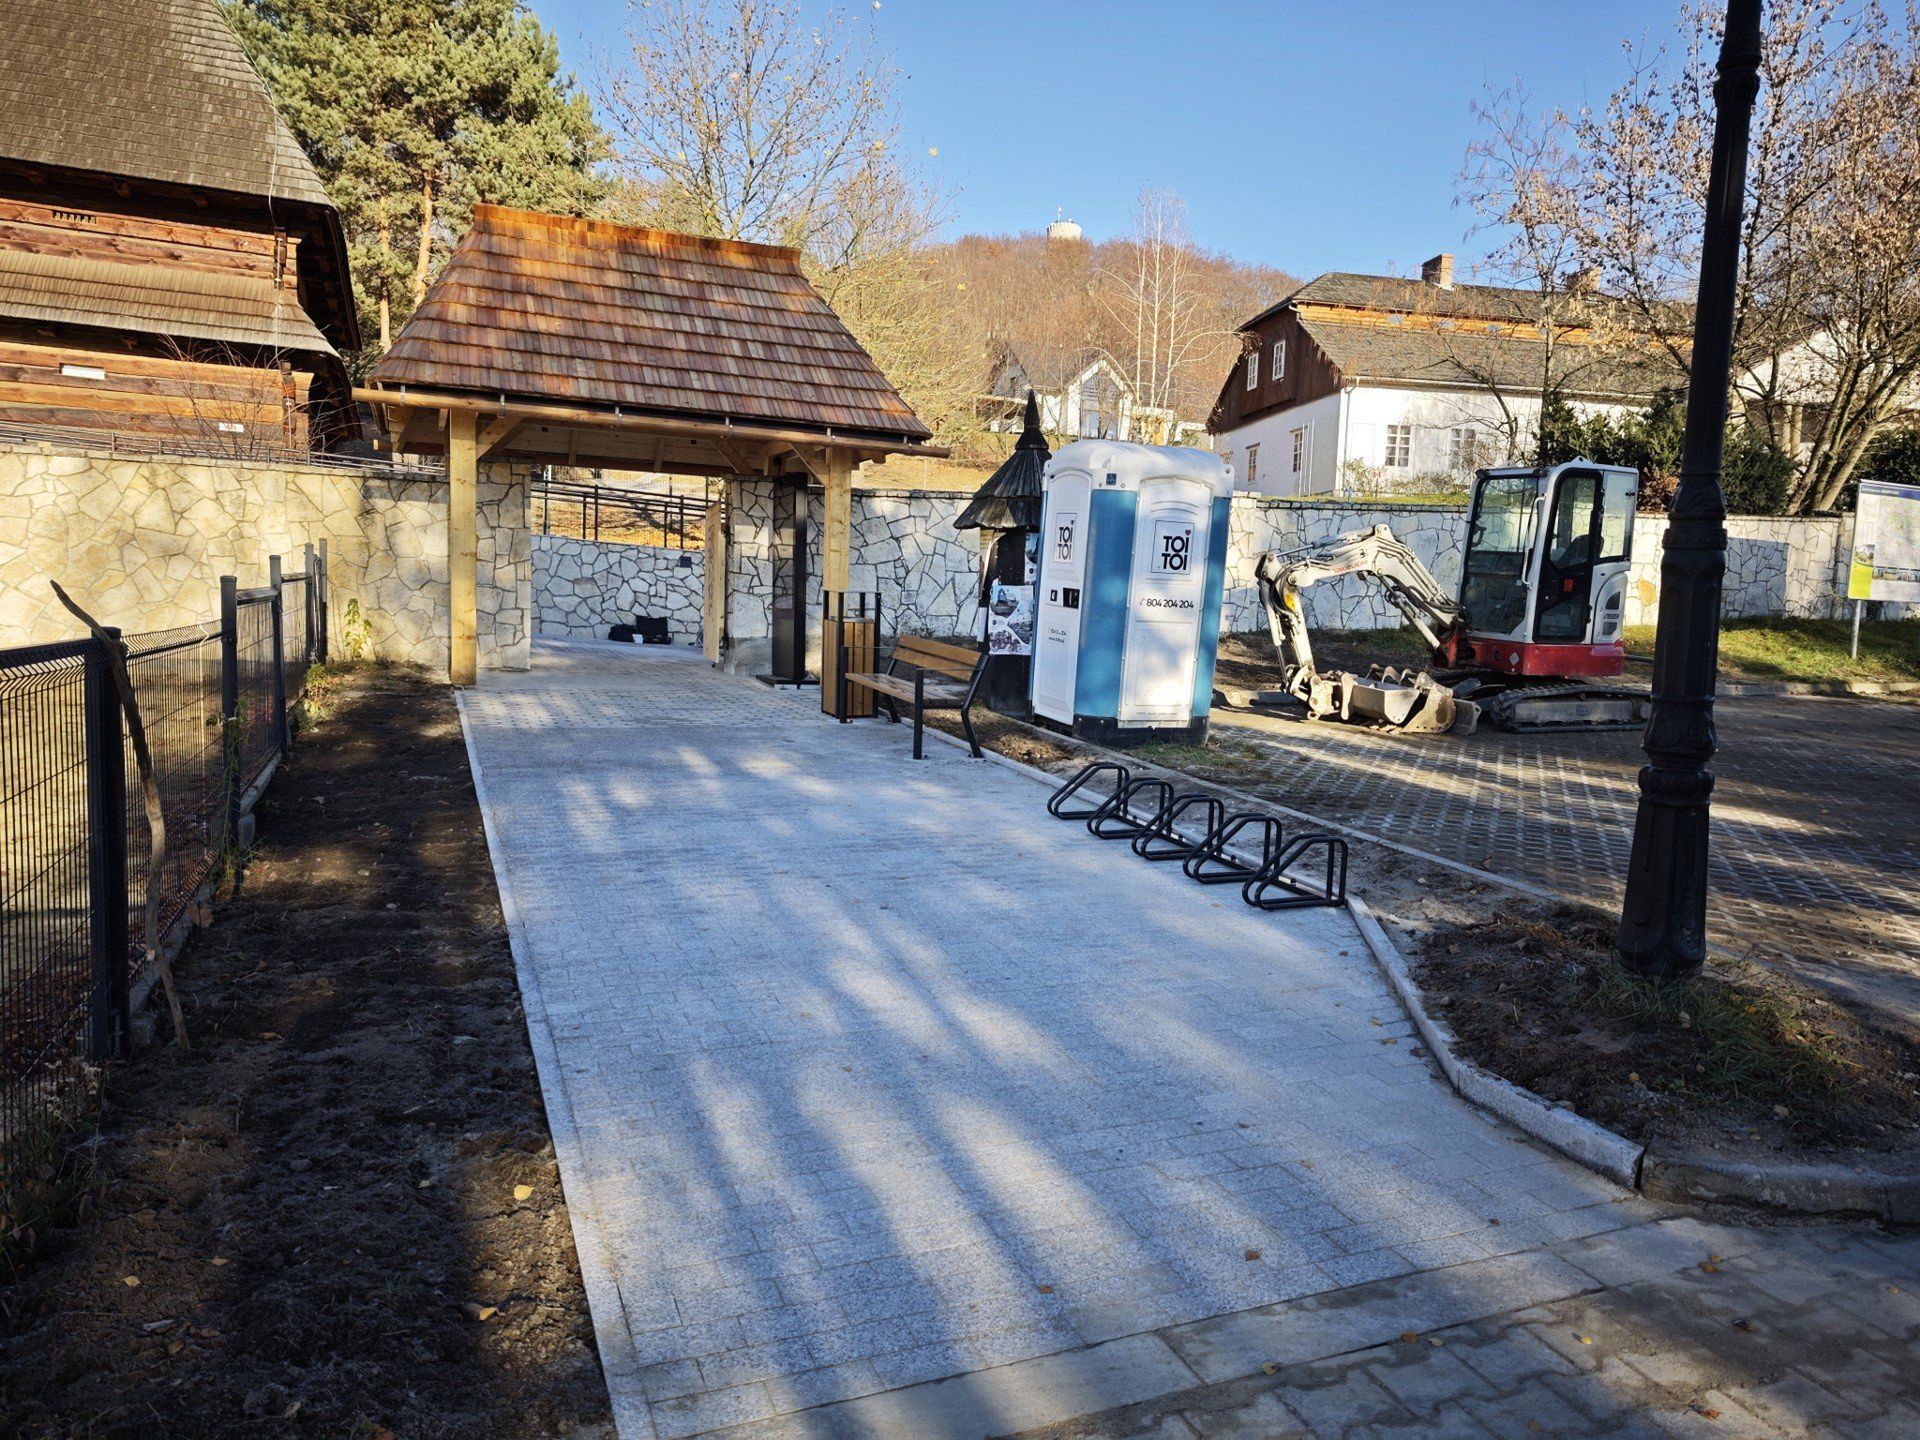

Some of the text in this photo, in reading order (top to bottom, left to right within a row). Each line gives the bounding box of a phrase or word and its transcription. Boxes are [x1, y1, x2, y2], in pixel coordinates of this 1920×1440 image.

[1057, 543, 1071, 560] TOI
[1161, 552, 1188, 571] TOI
[1146, 598, 1195, 609] 804 204 204
